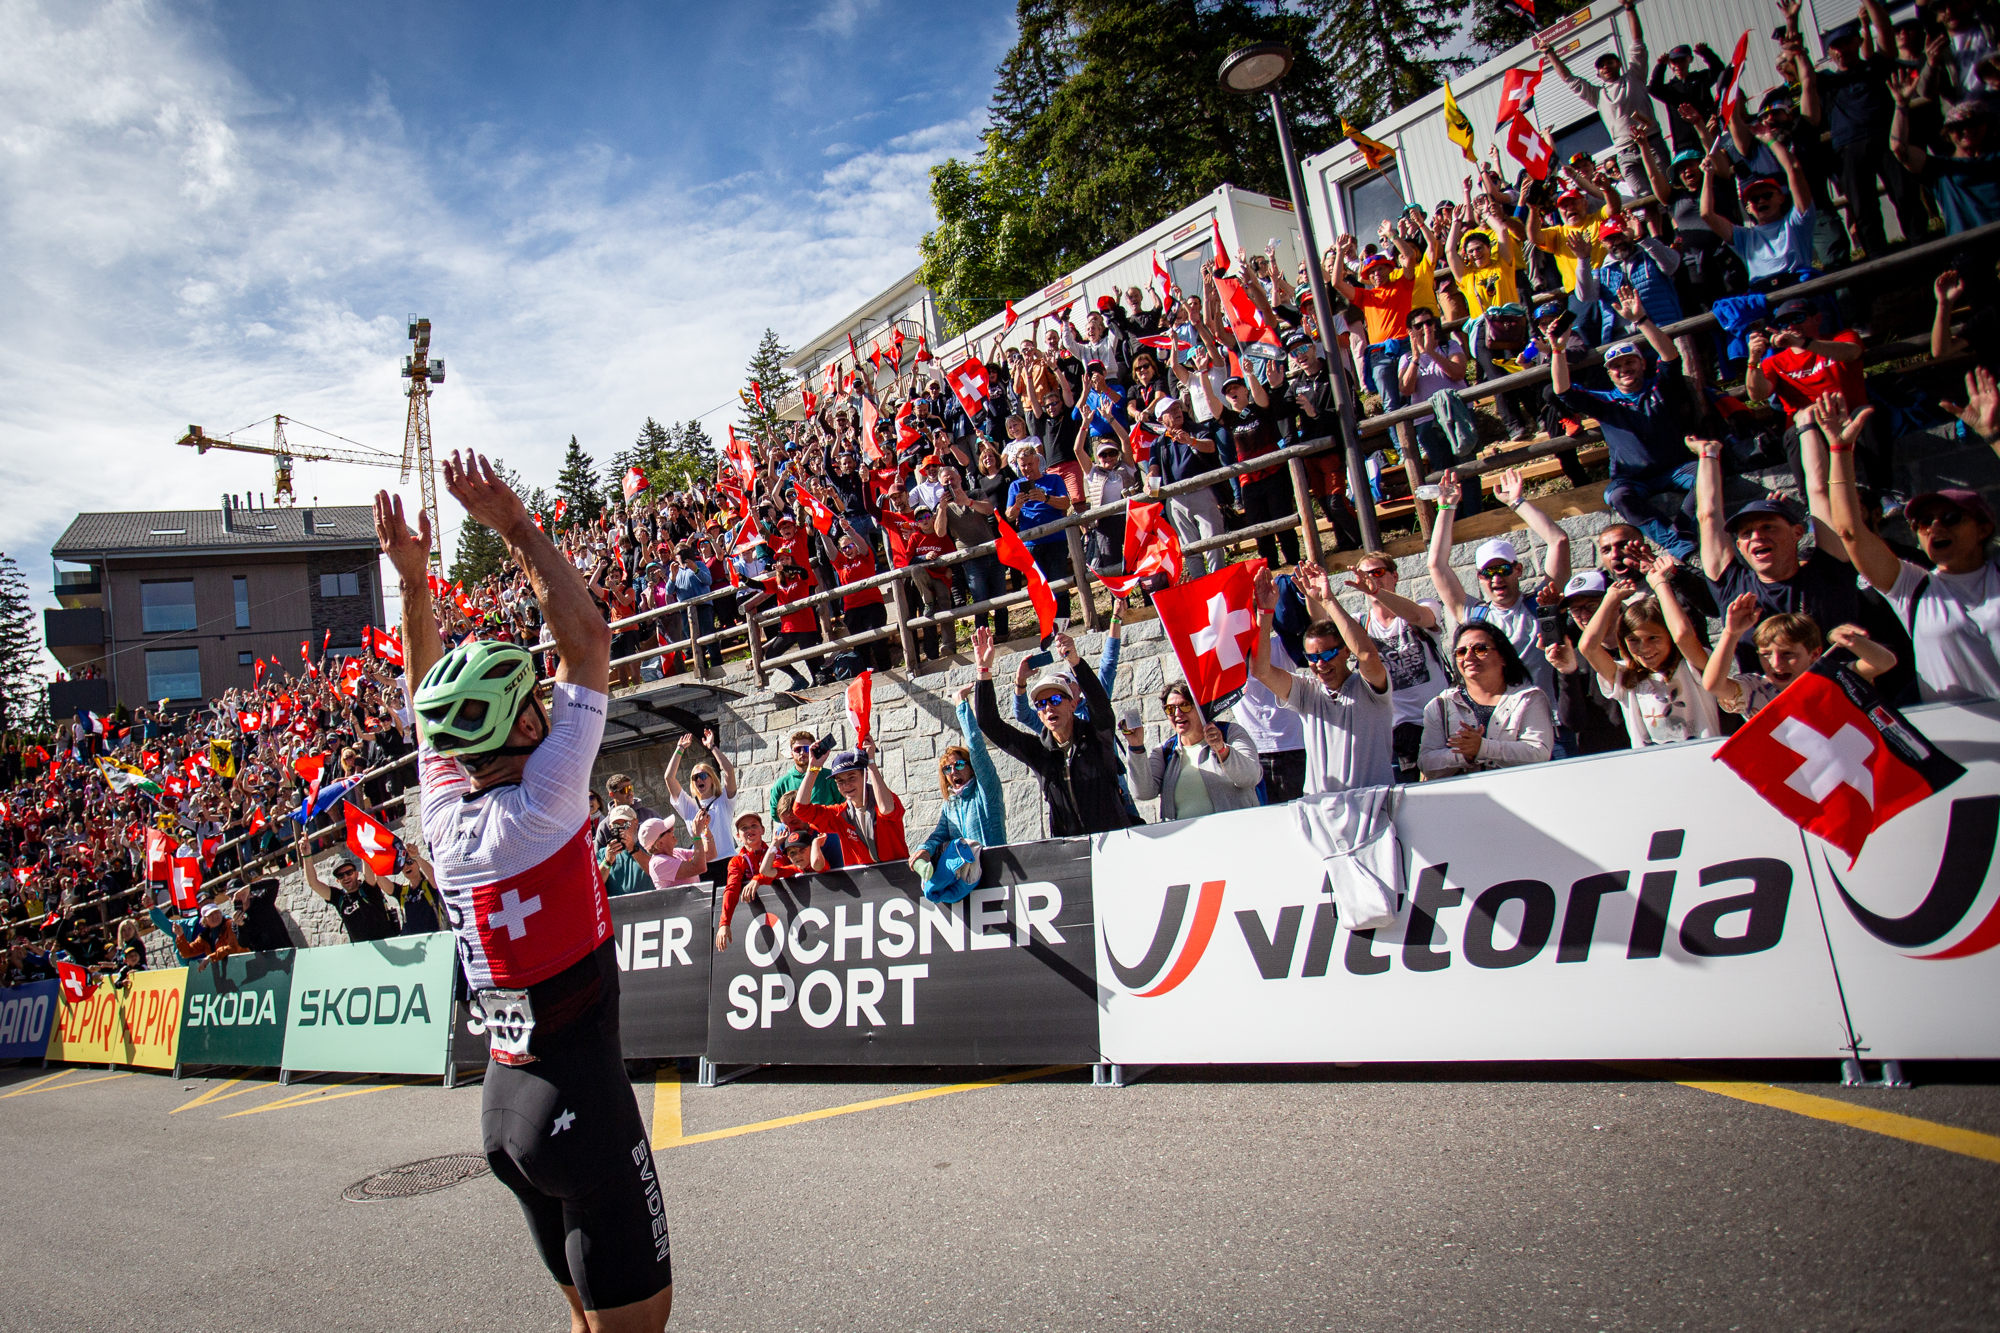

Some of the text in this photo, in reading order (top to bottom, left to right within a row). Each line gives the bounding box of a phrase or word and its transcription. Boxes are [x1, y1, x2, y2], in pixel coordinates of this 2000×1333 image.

[503, 663, 531, 696] SCOTT
[567, 701, 604, 716] VOLVO
[589, 849, 604, 921] TUDOR
[744, 880, 1067, 969] OCHSNER
[53, 992, 116, 1052] ALPIQ
[119, 987, 180, 1057] ALPIQ
[494, 1009, 526, 1043] 20
[726, 962, 929, 1030] SPORT
[631, 1139, 670, 1263] EVIDEN
